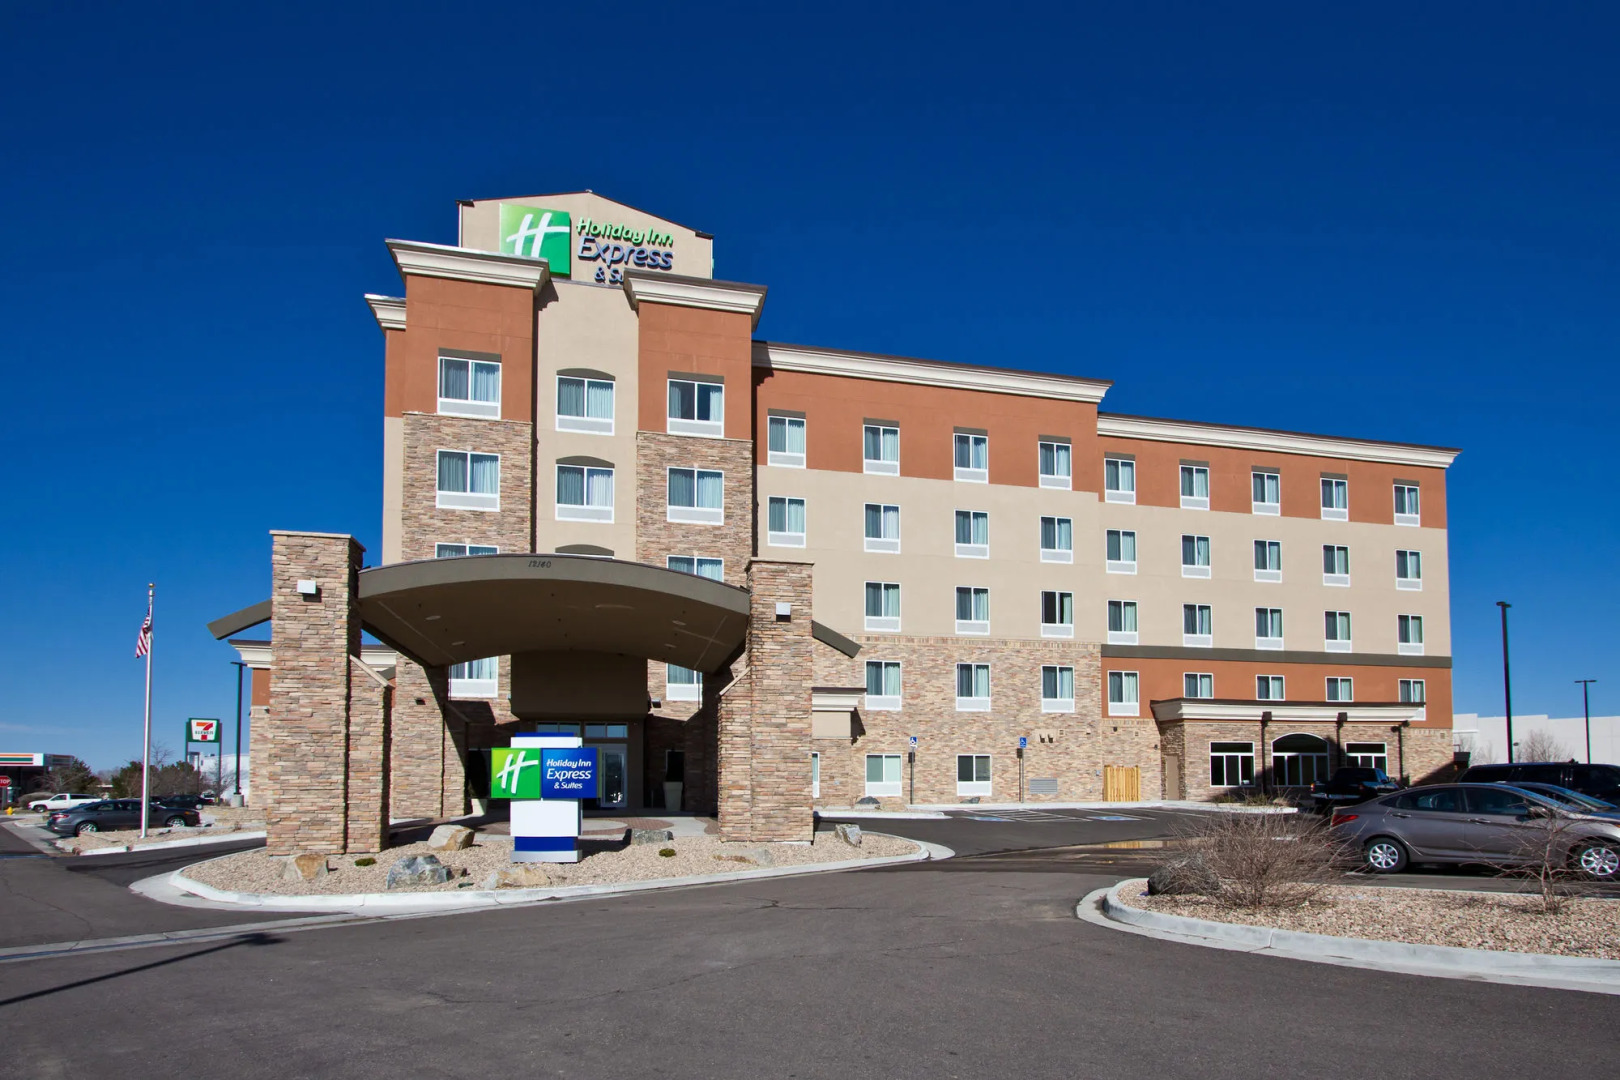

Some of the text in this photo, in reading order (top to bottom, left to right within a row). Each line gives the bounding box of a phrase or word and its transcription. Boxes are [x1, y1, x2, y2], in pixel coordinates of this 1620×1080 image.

[576, 216, 674, 247] Holiday Inn
[577, 234, 674, 269] Express
[594, 266, 606, 283] &
[546, 758, 592, 769] Holiday Inn
[546, 768, 591, 781] Express
[553, 781, 583, 789] & Suites
